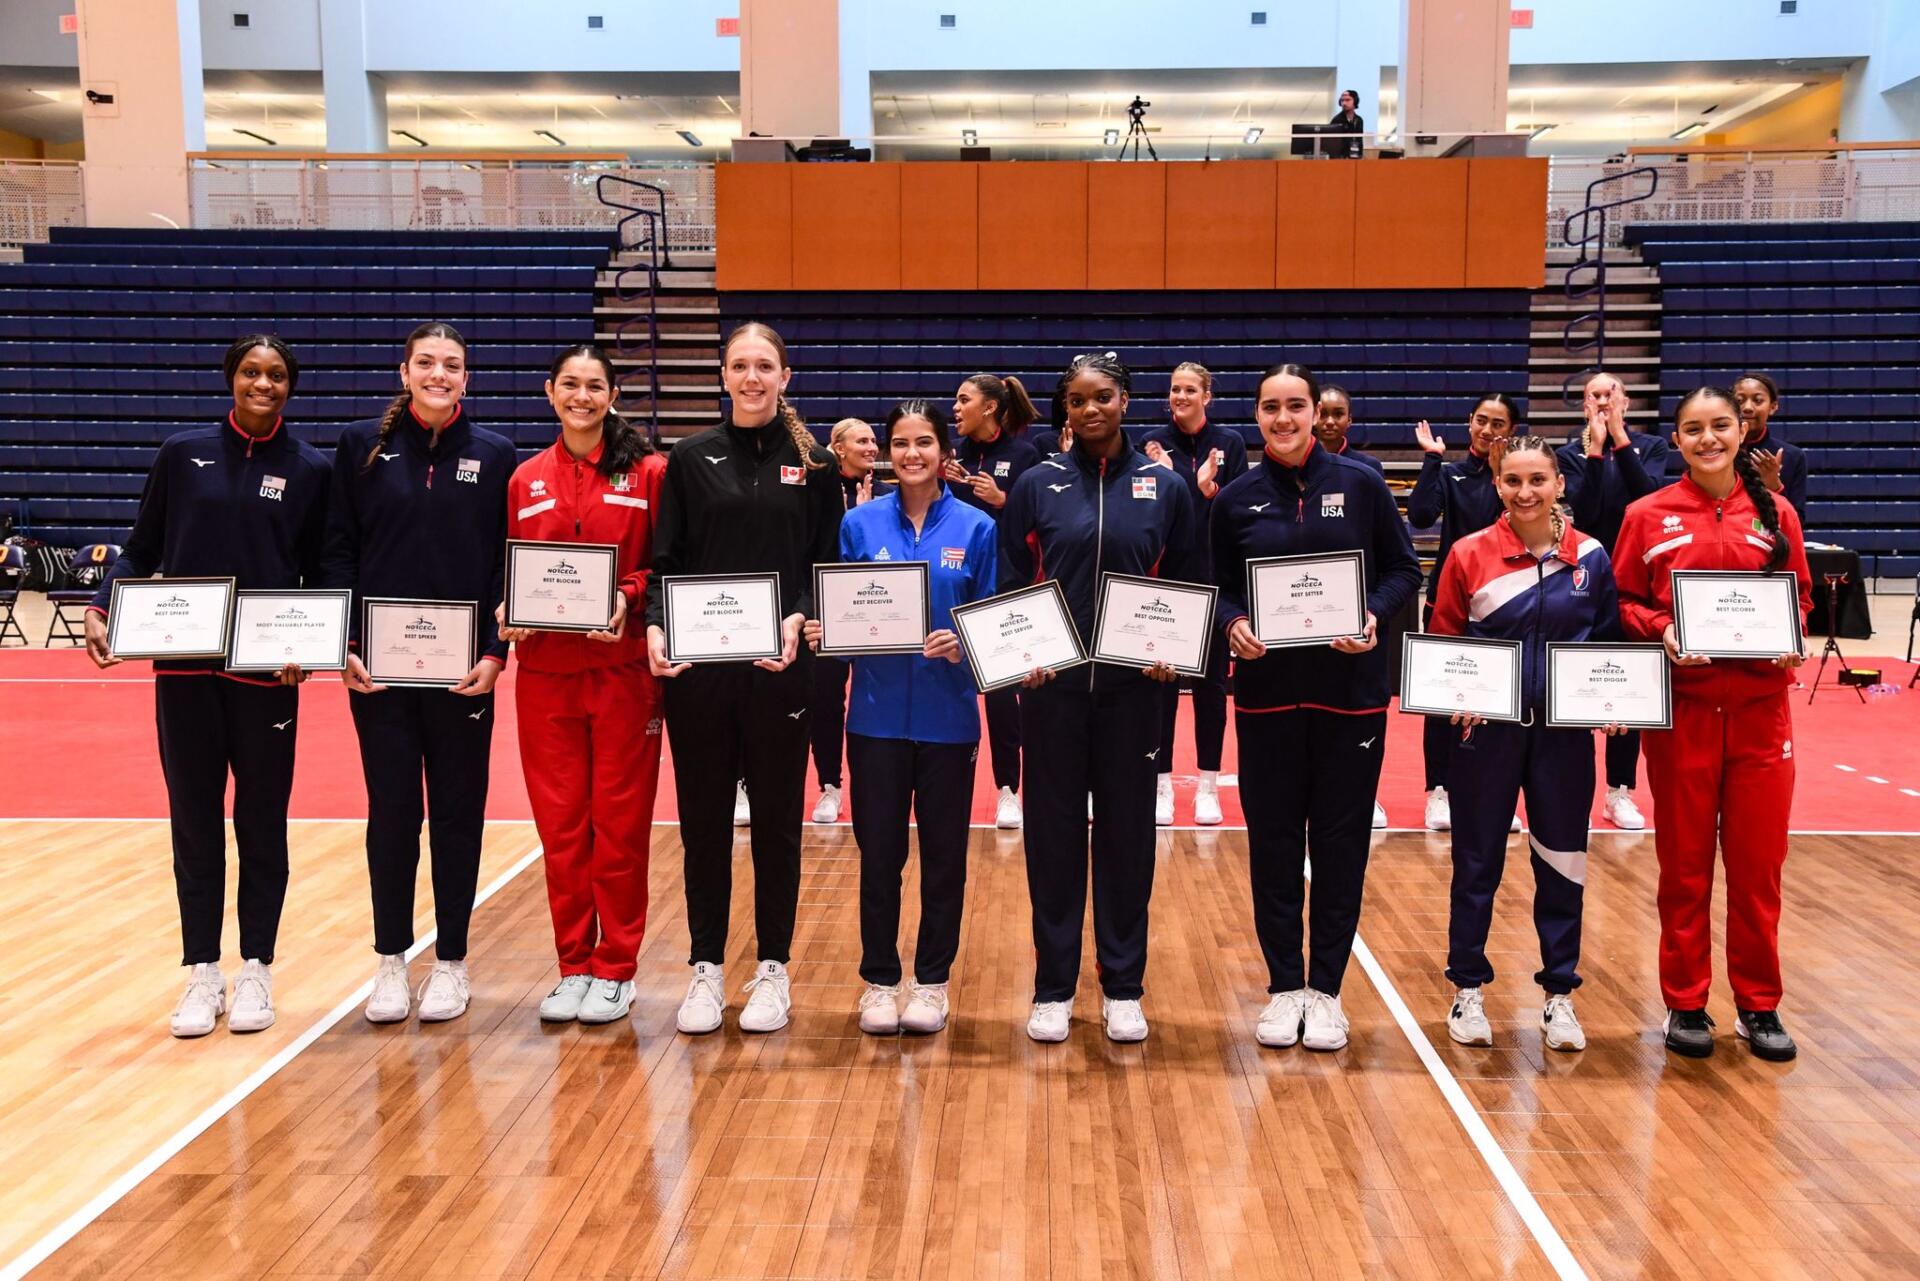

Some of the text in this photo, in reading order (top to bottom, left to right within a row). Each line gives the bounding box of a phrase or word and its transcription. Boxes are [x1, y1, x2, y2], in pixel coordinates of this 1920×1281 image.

[456, 470, 478, 484] USA
[994, 469, 1009, 477] USA
[259, 486, 282, 501] USA
[1321, 506, 1345, 518] USA
[1148, 614, 1176, 624] OPPOSITE
[1001, 624, 1033, 637] BEST SERVER
